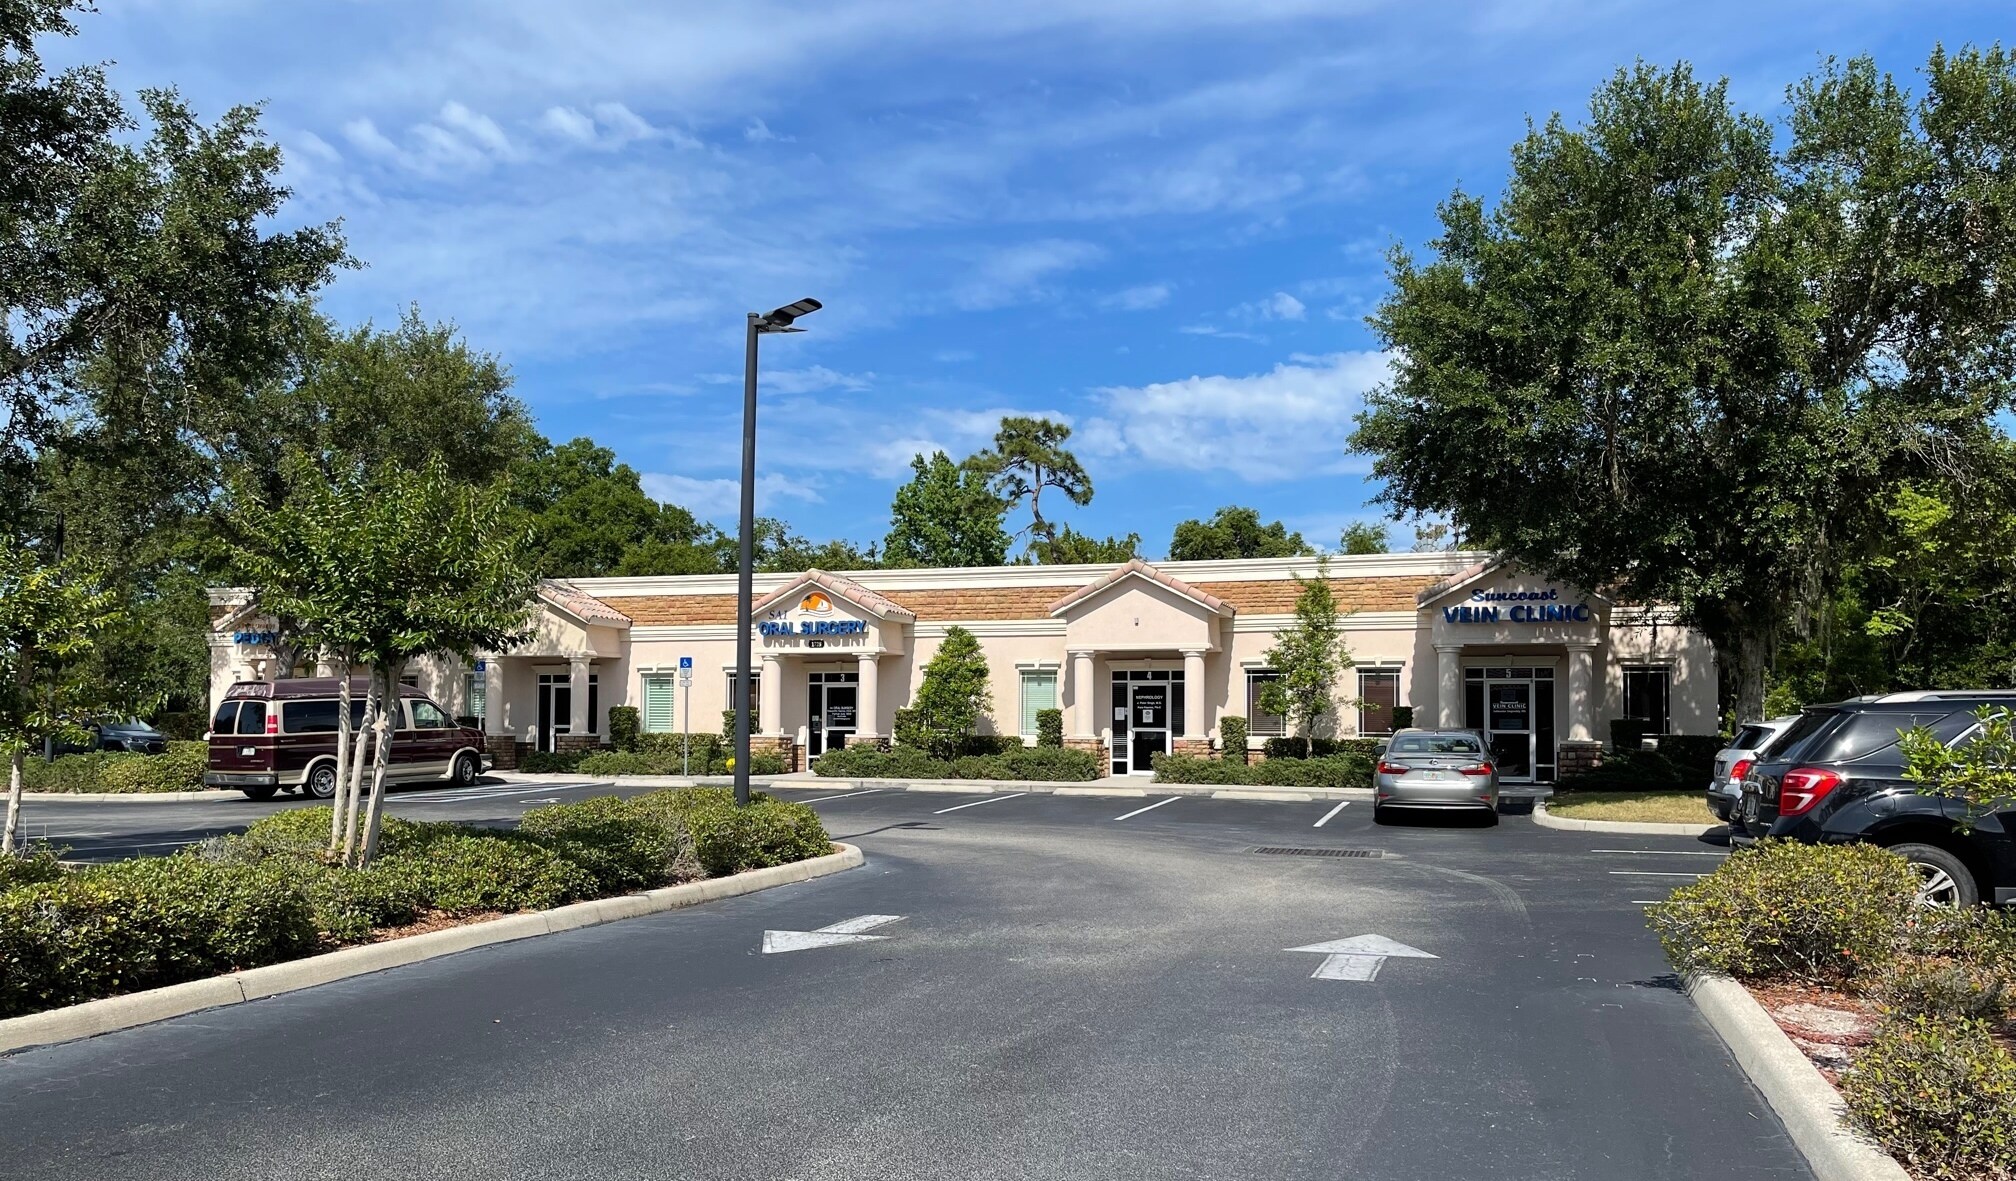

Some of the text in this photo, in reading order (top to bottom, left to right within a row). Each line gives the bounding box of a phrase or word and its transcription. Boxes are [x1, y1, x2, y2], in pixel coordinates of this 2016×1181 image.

[1471, 588, 1559, 602] Suncoast
[769, 610, 787, 619] SAI
[1442, 603, 1589, 624] VEIN CLINIC
[759, 620, 867, 636] ORAL SURGERY
[840, 673, 845, 682] 3
[1147, 671, 1152, 680] 4
[1505, 668, 1512, 678] 5
